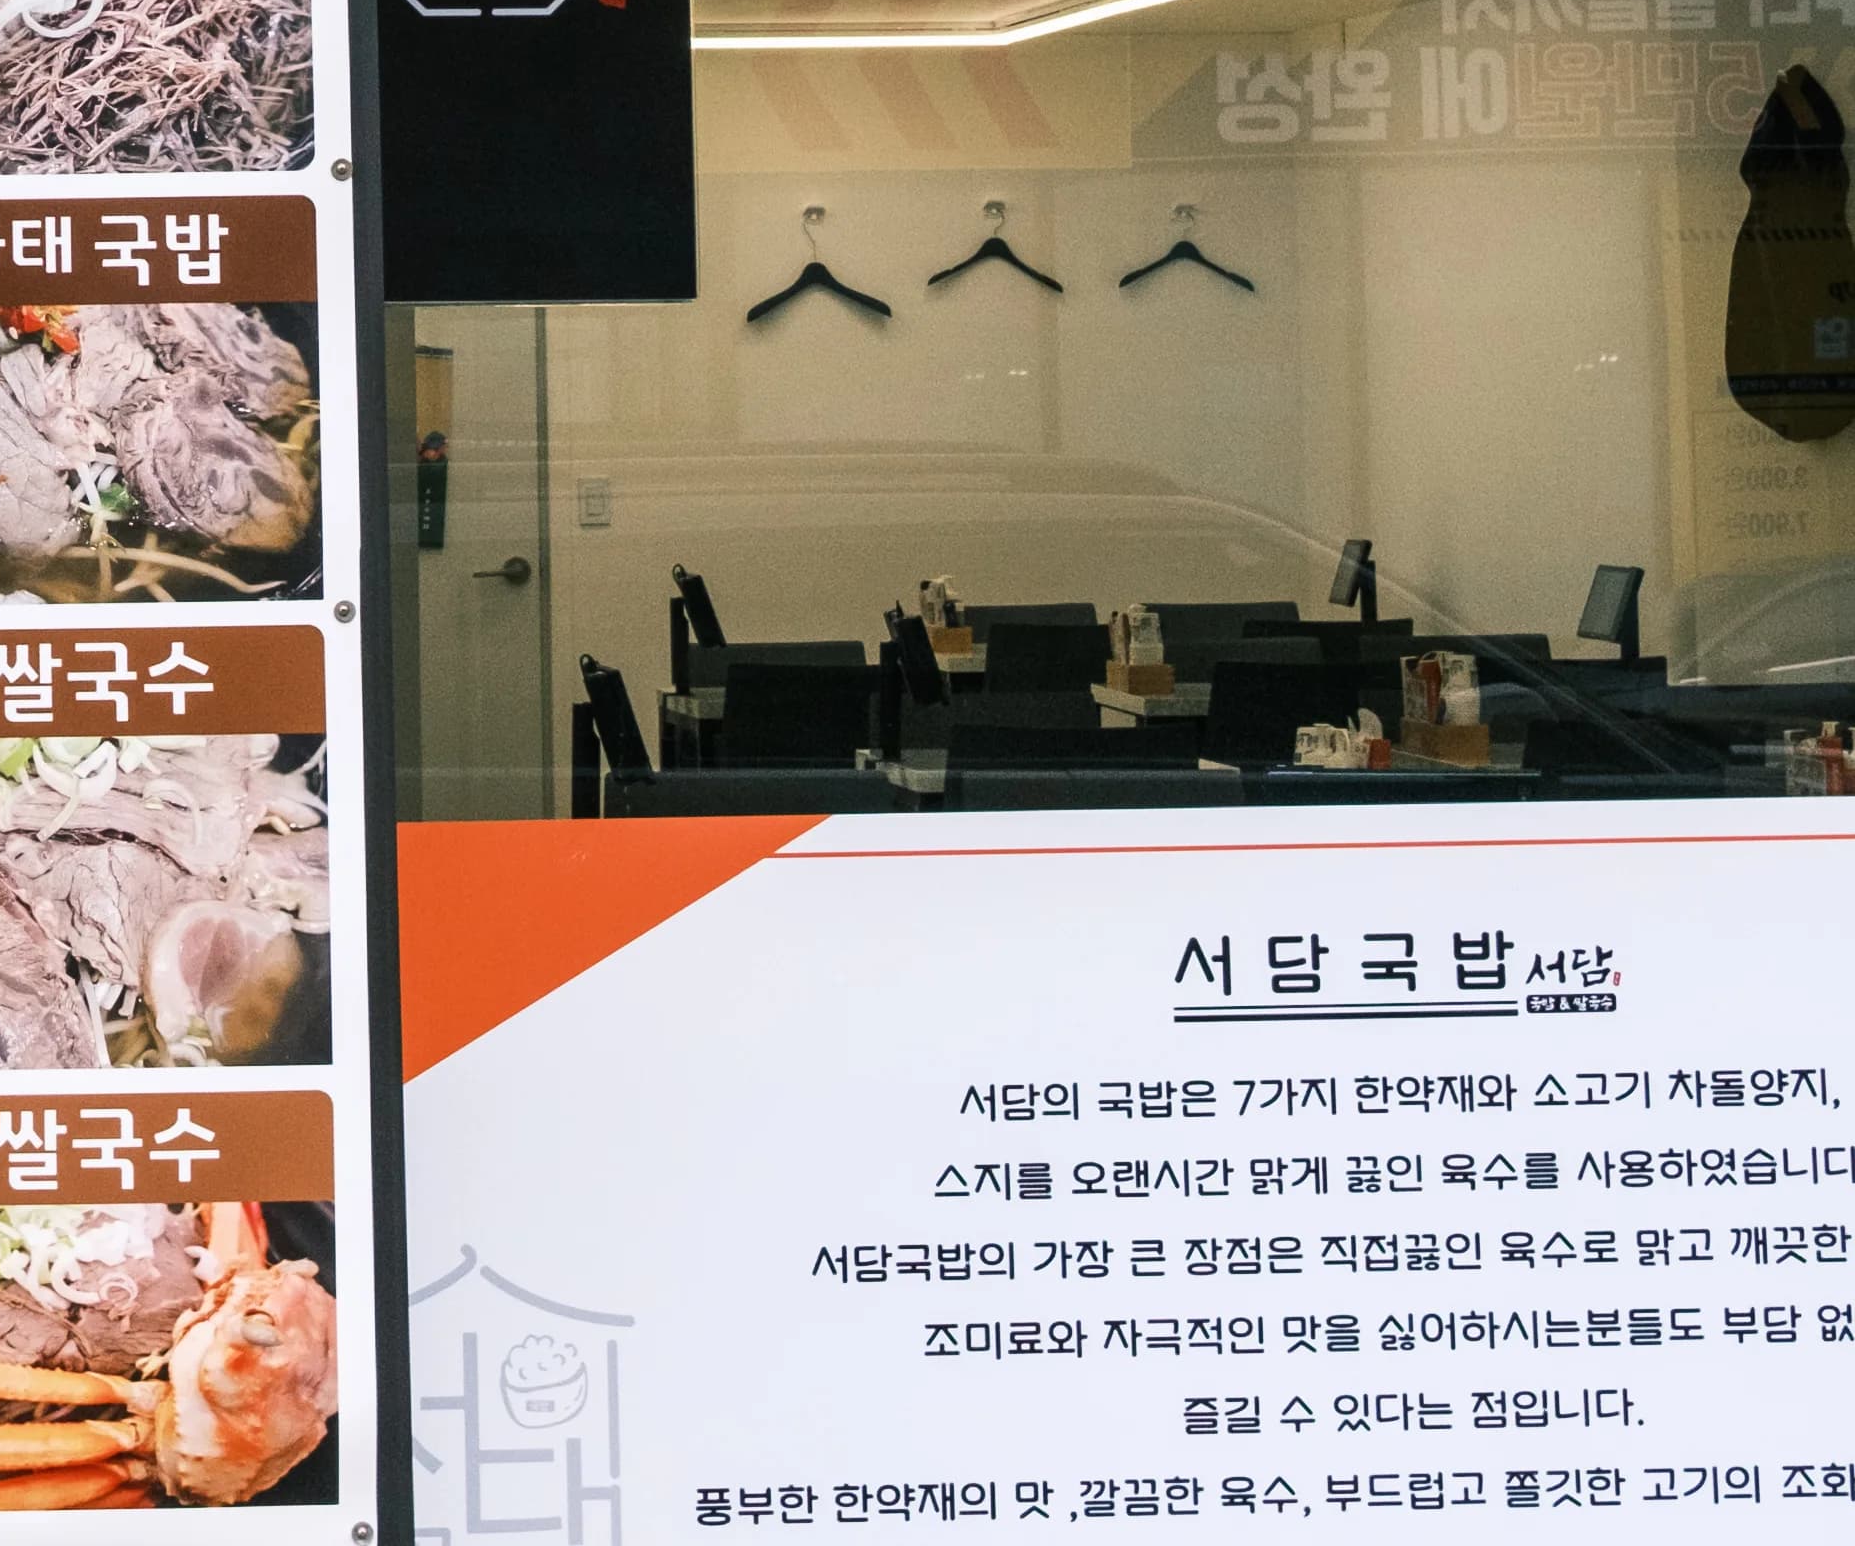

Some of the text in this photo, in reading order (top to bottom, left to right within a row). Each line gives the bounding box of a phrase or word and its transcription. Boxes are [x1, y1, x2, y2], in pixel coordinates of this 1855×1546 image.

[93, 213, 230, 287] 국밥
[1525, 945, 1614, 988] 서담
[960, 1068, 1840, 1122] 서담의 국밥은 7가지 한약재와 소고기 차돌양지,
[934, 1162, 1053, 1201] 스지를
[1071, 1158, 1234, 1198] 오랜시간
[1250, 1156, 1328, 1195] 맑게
[1346, 1154, 1423, 1193] 끓인
[1441, 1152, 1559, 1191] 육수를
[812, 1223, 1852, 1284] 서담국밥의 가장 큰 장점은 직접끓인 육수로 맑고 깨끗한
[924, 1320, 1088, 1360] 조미료와
[1103, 1316, 1265, 1357] 자극적인
[1283, 1314, 1361, 1353] 맛을
[1378, 1308, 1705, 1351] 싫어하시는분들도
[1723, 1305, 1802, 1344] 부담
[1183, 1388, 1644, 1435] 즐길 수 있다는 점입니다.
[695, 1484, 819, 1526] 풍부한
[833, 1481, 997, 1523] 한약재의
[1015, 1480, 1054, 1519] 맛
[1221, 1476, 1311, 1517] 육수,
[1326, 1472, 1486, 1512] 부드럽고
[1505, 1467, 1626, 1508] 쫄깃한
[1643, 1465, 1761, 1504] 고기의
